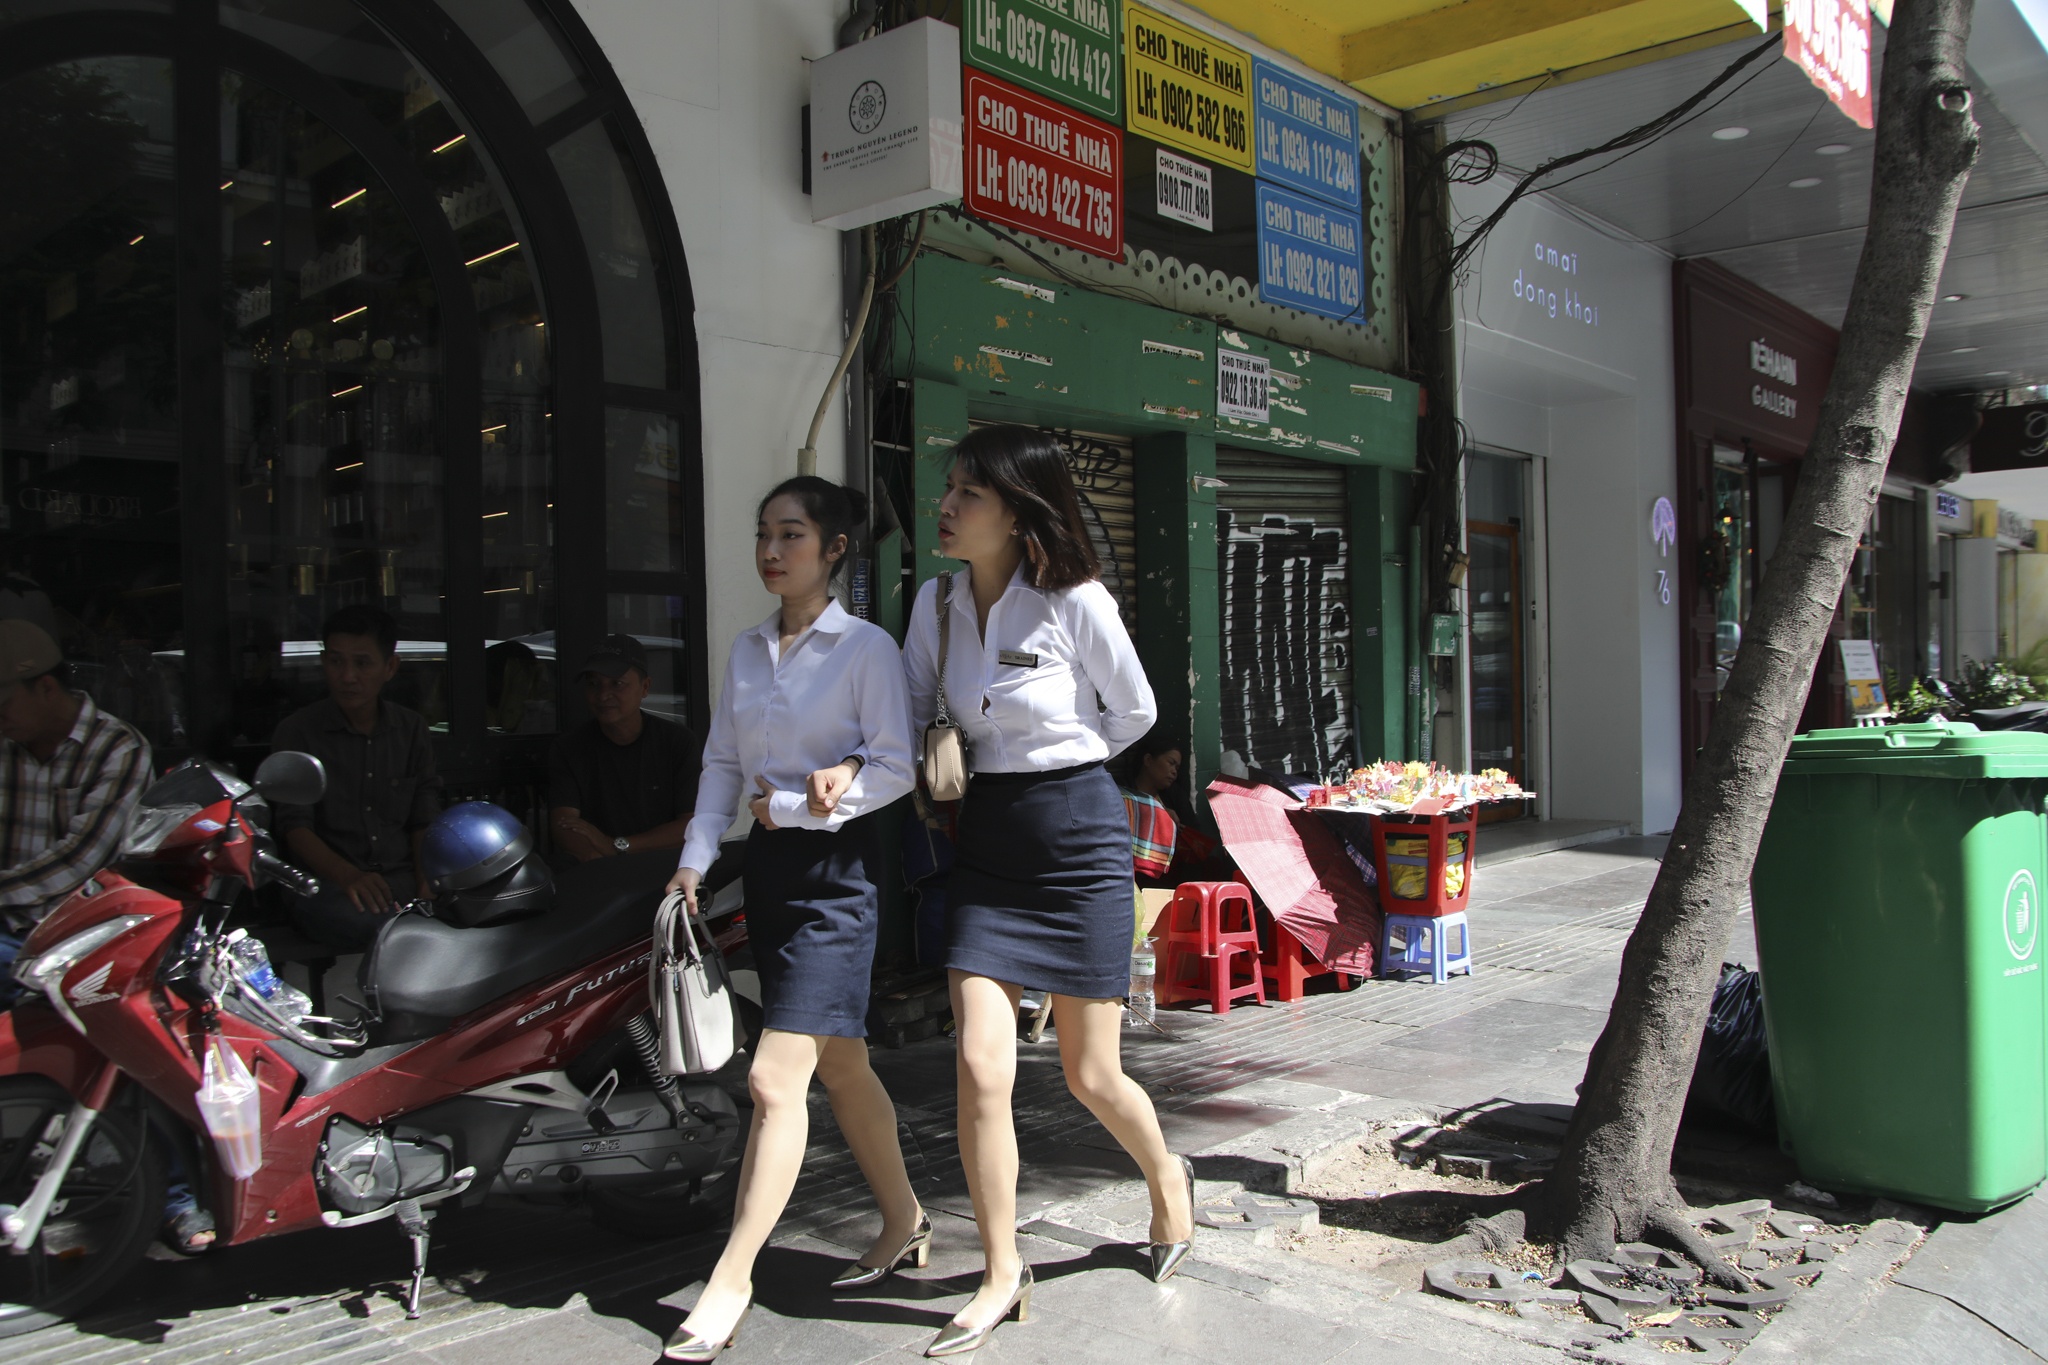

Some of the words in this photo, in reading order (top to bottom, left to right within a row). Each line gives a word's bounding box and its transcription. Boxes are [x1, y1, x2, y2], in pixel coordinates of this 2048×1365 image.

[976, 0, 1002, 54] LH:
[1006, 8, 1047, 72] 0937
[1051, 28, 1080, 87] 374
[1083, 43, 1112, 100] 412
[1135, 24, 1168, 61] CHO
[1171, 38, 1210, 80] THUÊ
[1213, 57, 1245, 94] NHÀ
[977, 95, 1018, 137] CHO
[1022, 112, 1070, 158] THUÊ
[1075, 133, 1113, 174] NHÀ
[1136, 68, 1159, 121] LH:
[1160, 79, 1194, 134] 0902
[1196, 93, 1221, 144] 582
[1223, 104, 1246, 154] 966
[1261, 77, 1289, 112] CHO
[1291, 90, 1324, 127] THUÊ
[1325, 106, 1353, 139] NHÀ
[832, 147, 855, 160] TRUNG
[889, 126, 918, 140] LEGEND
[1159, 156, 1175, 171] CHO
[1175, 162, 1194, 178] THUÊ
[1260, 117, 1280, 166] LH:
[1281, 126, 1311, 178] 0934
[1312, 140, 1334, 187] 112
[1334, 148, 1356, 195] 284
[977, 143, 1003, 203] LH:
[1007, 155, 1049, 219] 0933
[1052, 173, 1081, 230] 422
[1084, 184, 1114, 241] 735
[1265, 200, 1293, 232] CHO
[1295, 210, 1328, 244] THUÊ
[1329, 221, 1357, 253] NHÀ
[1264, 241, 1285, 288] LH:
[1285, 248, 1315, 296] 0982
[1315, 257, 1337, 302] 821
[1338, 263, 1360, 308] 829
[1534, 242, 1578, 276] amaï
[1513, 268, 1558, 319] dong
[1565, 287, 1599, 328] khoi
[1221, 355, 1236, 368] CHO
[1235, 358, 1252, 372] THUÊ
[1252, 361, 1266, 375] NHÀ
[1751, 384, 1798, 420] GALLERY
[1657, 570, 1671, 605] 76
[564, 951, 653, 1007] FUTUR
